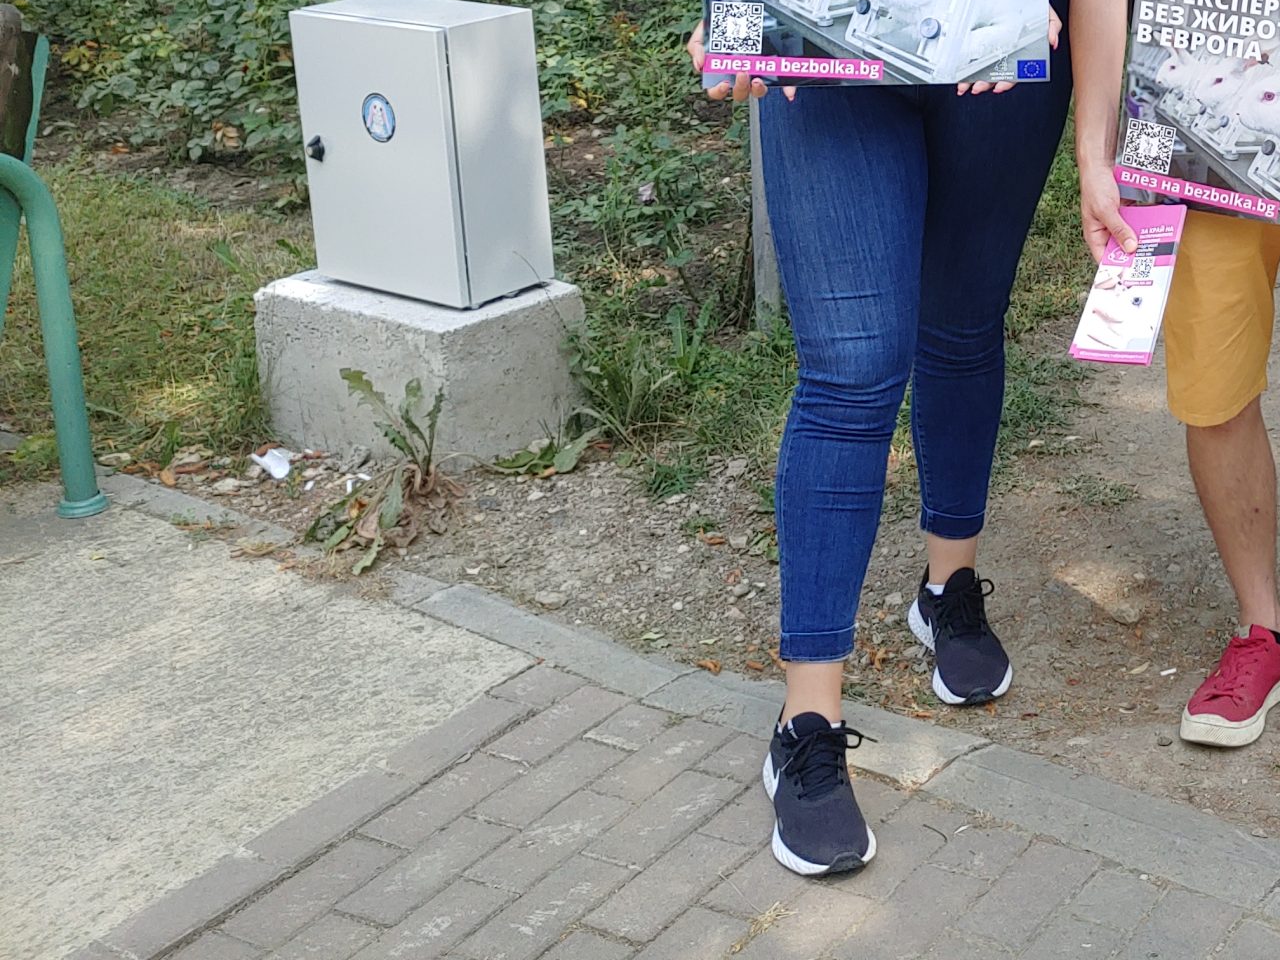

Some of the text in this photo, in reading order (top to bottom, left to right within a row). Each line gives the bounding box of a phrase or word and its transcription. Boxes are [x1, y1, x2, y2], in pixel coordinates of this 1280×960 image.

[1139, 1, 1184, 24] БЕЗ
[1137, 23, 1261, 62] В ЕВРОПА
[711, 58, 880, 78] влез на bezbolka.bg
[1121, 171, 1275, 218] влез на bezbolka.bg
